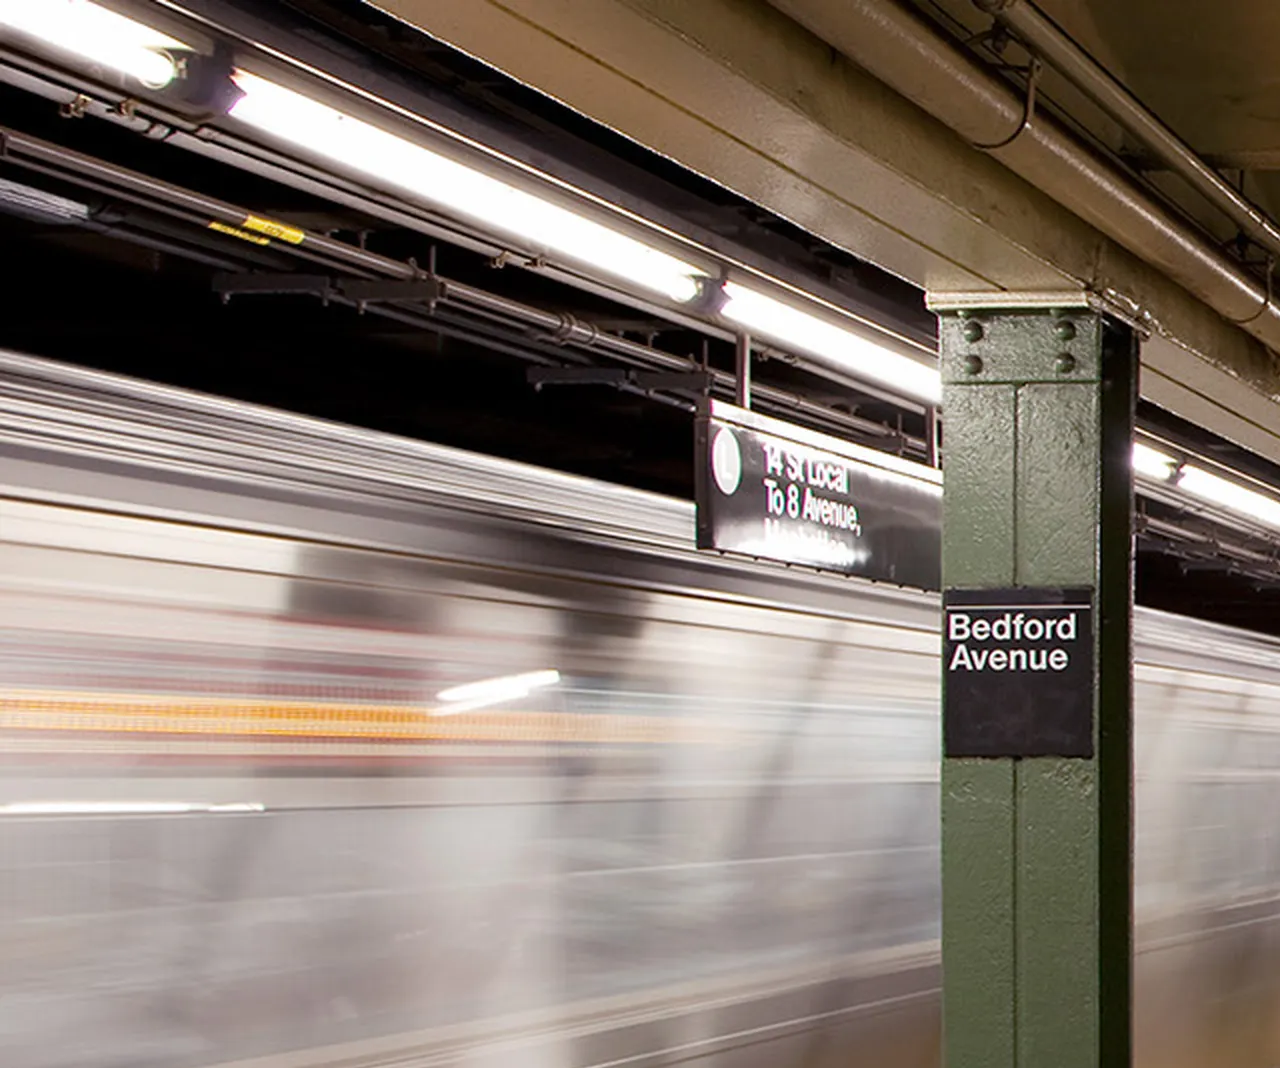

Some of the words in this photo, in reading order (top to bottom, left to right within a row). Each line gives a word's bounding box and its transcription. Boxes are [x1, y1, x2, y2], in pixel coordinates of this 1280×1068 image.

[763, 442, 783, 476] 14
[784, 452, 805, 482] St
[806, 458, 849, 494] Local
[764, 477, 785, 516] To
[786, 483, 800, 519] 8
[802, 487, 862, 537] Avenue,
[949, 612, 1077, 641] Bedford
[949, 643, 1069, 671] Avenue
